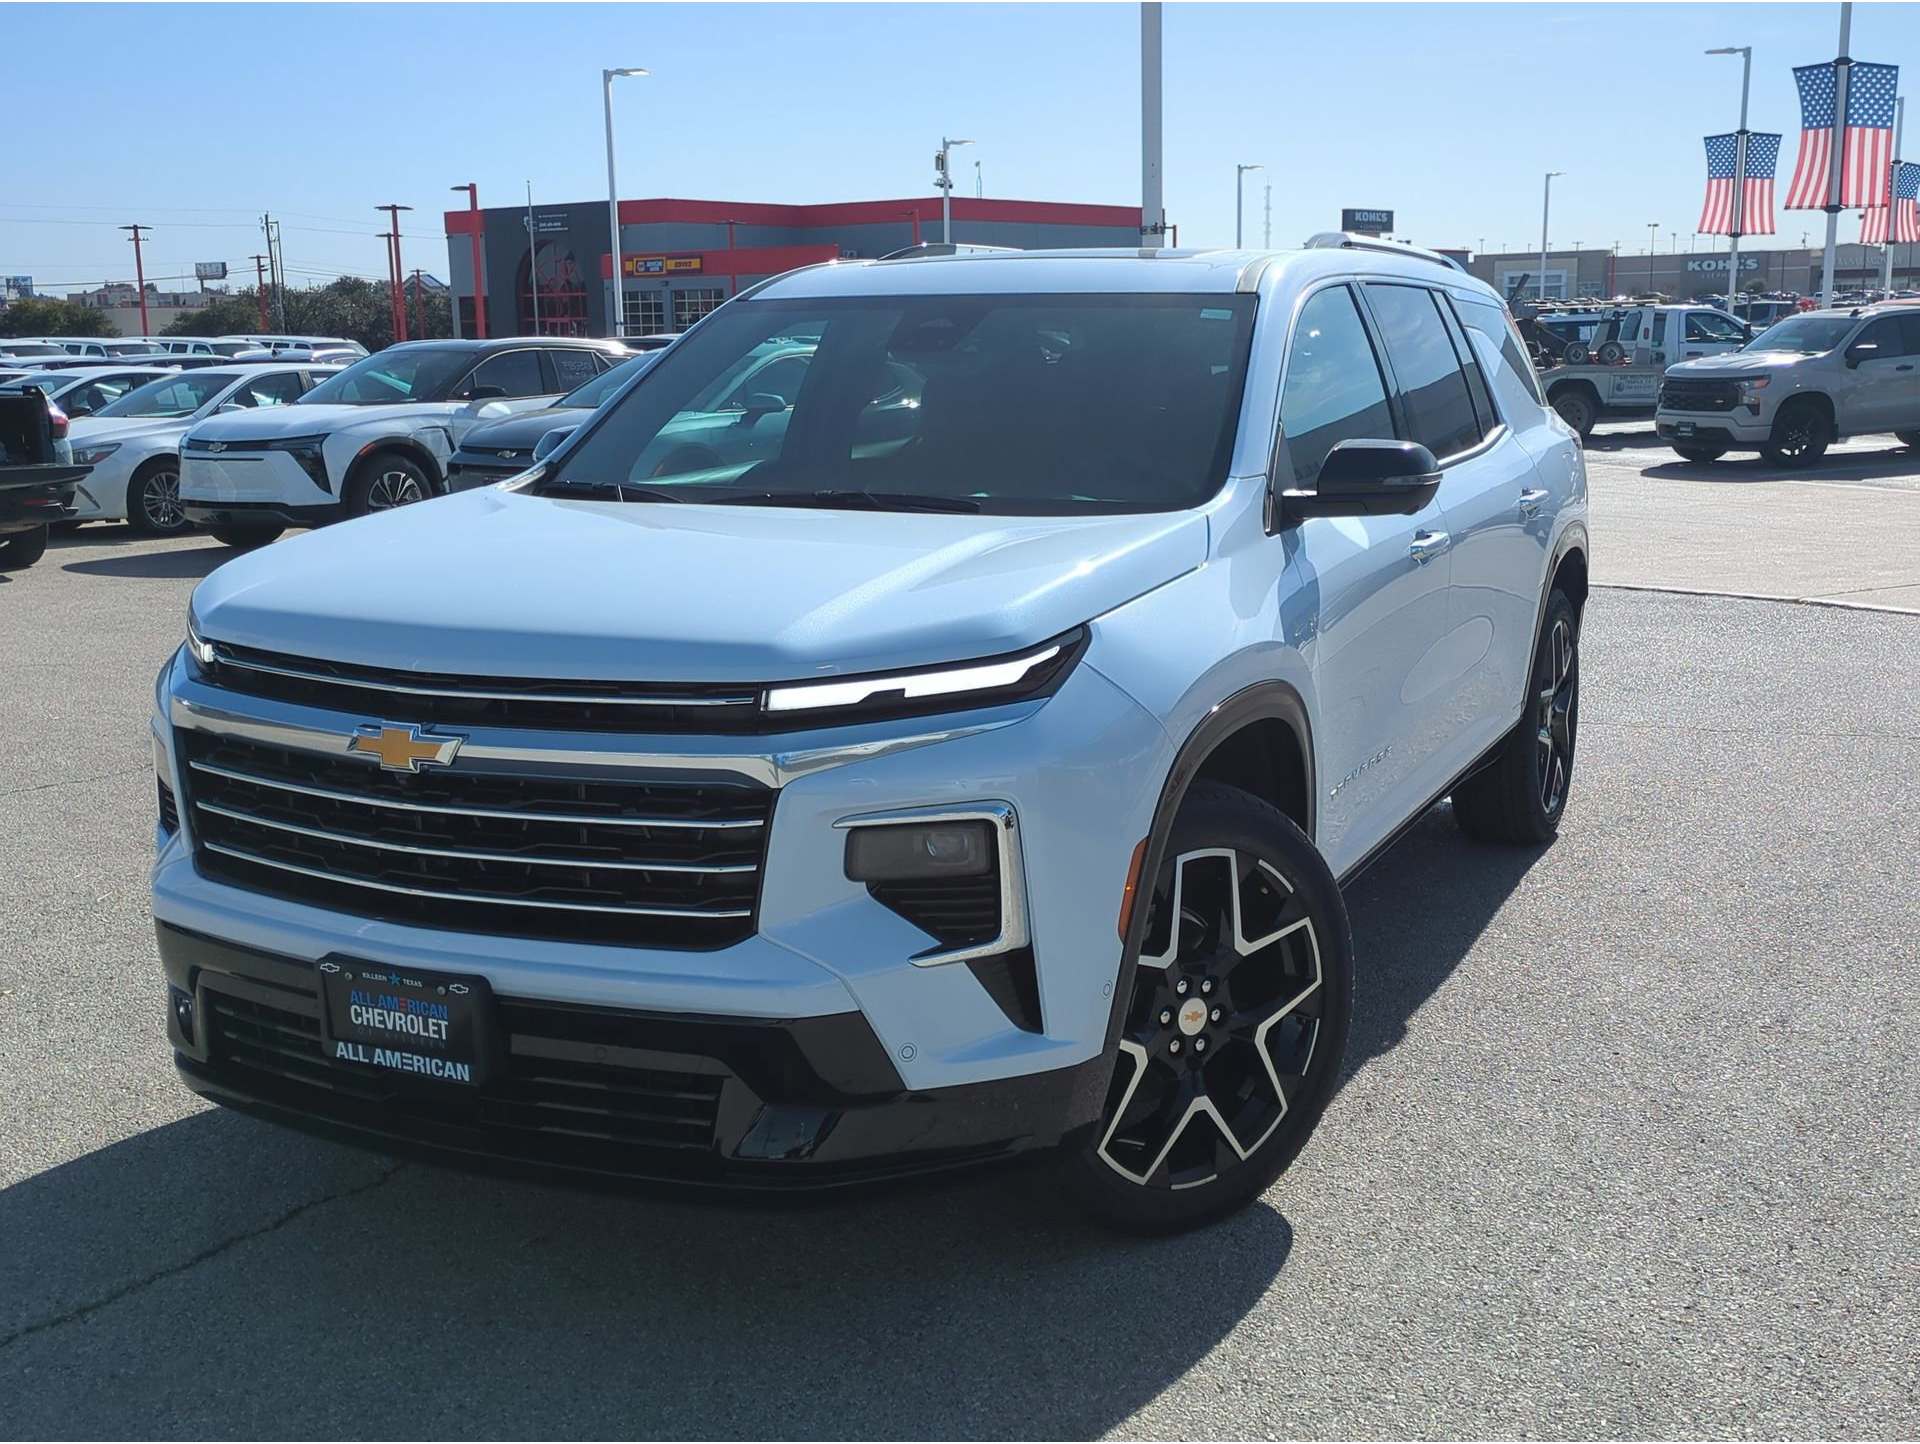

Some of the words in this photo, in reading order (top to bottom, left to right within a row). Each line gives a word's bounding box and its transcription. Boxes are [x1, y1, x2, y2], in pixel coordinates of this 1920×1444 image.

[1355, 211, 1388, 222] KOHL'S
[1687, 258, 1758, 271] KOH'S
[402, 978, 423, 988] TEXAS
[351, 990, 375, 1007] ALL
[378, 994, 448, 1019] AMERICAN
[350, 1004, 449, 1040] CHEVROLET
[336, 1041, 369, 1063] ALL
[373, 1048, 470, 1082] AMERICAN
